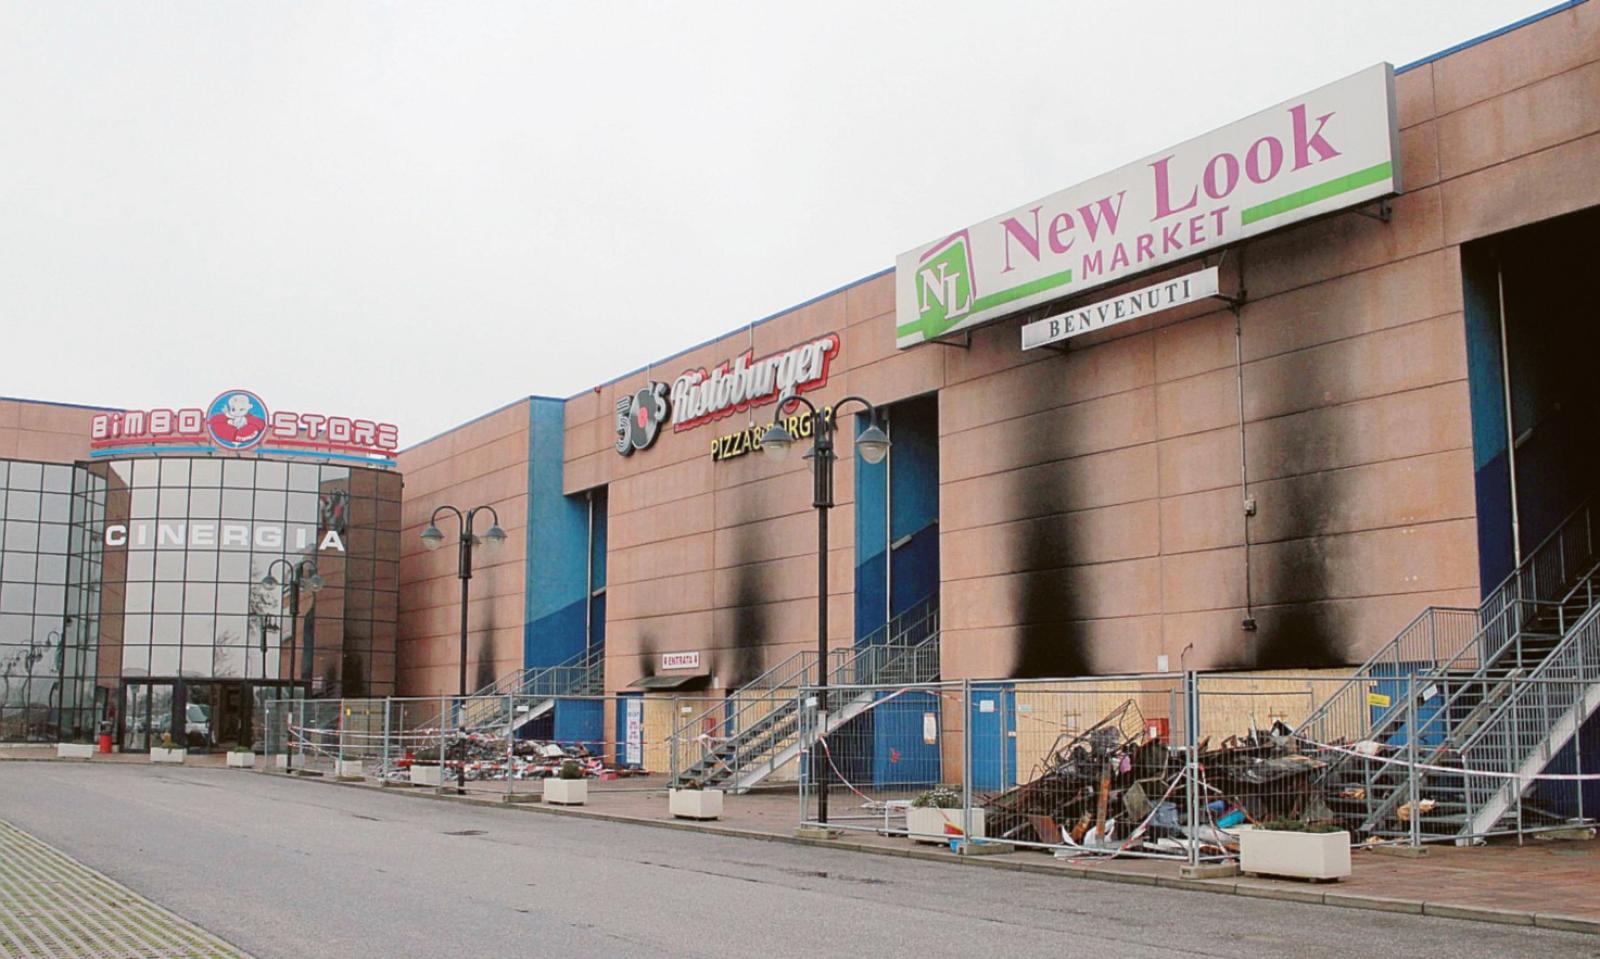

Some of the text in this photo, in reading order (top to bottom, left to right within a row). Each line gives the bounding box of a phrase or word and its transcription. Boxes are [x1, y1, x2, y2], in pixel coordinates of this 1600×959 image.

[1000, 103, 1342, 273] New Look
[1081, 206, 1231, 280] MARKET
[918, 262, 974, 322] NL
[1049, 279, 1192, 339] BENVENUTI
[671, 338, 836, 427] Ristoburger
[272, 411, 398, 449] STORE
[105, 523, 346, 552] CINERGIA
